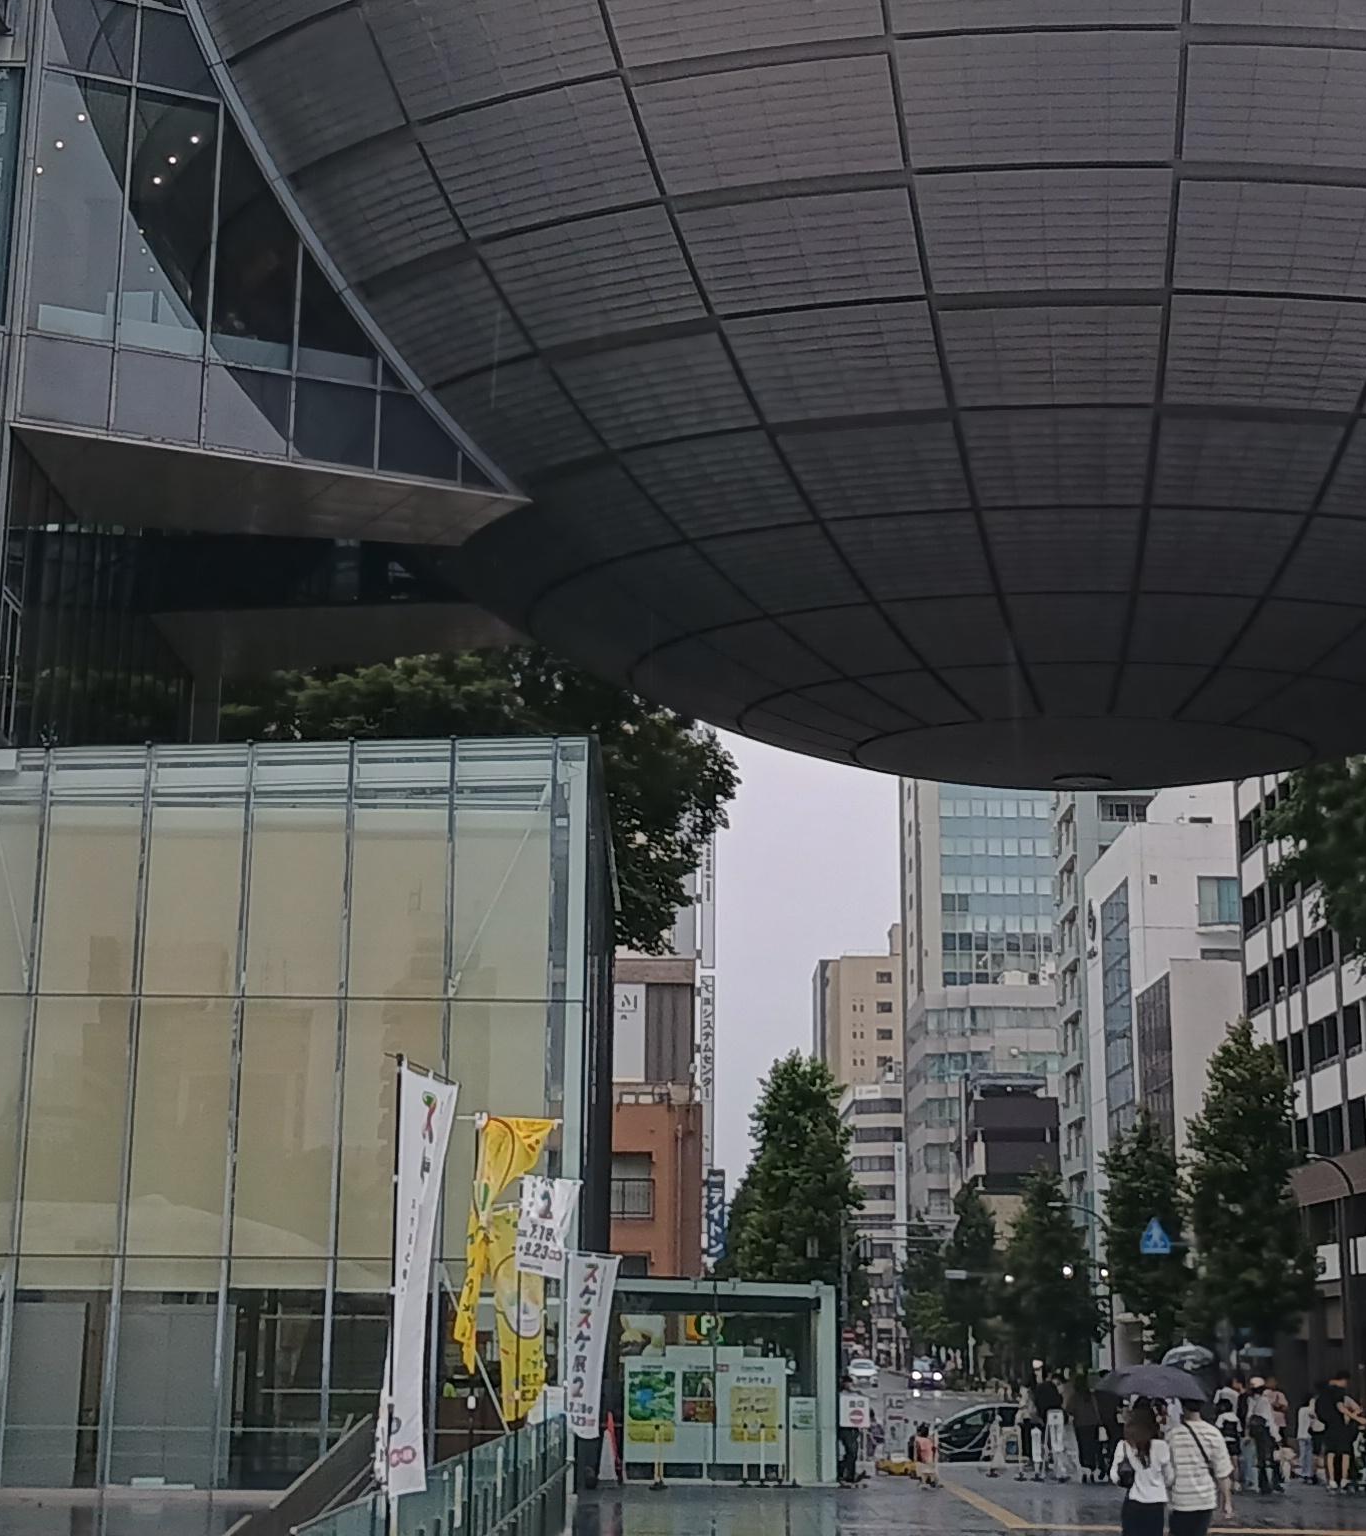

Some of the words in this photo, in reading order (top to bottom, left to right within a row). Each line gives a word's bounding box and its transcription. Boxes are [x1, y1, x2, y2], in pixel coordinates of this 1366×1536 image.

[571, 1263, 599, 1398] スケスケ展2
